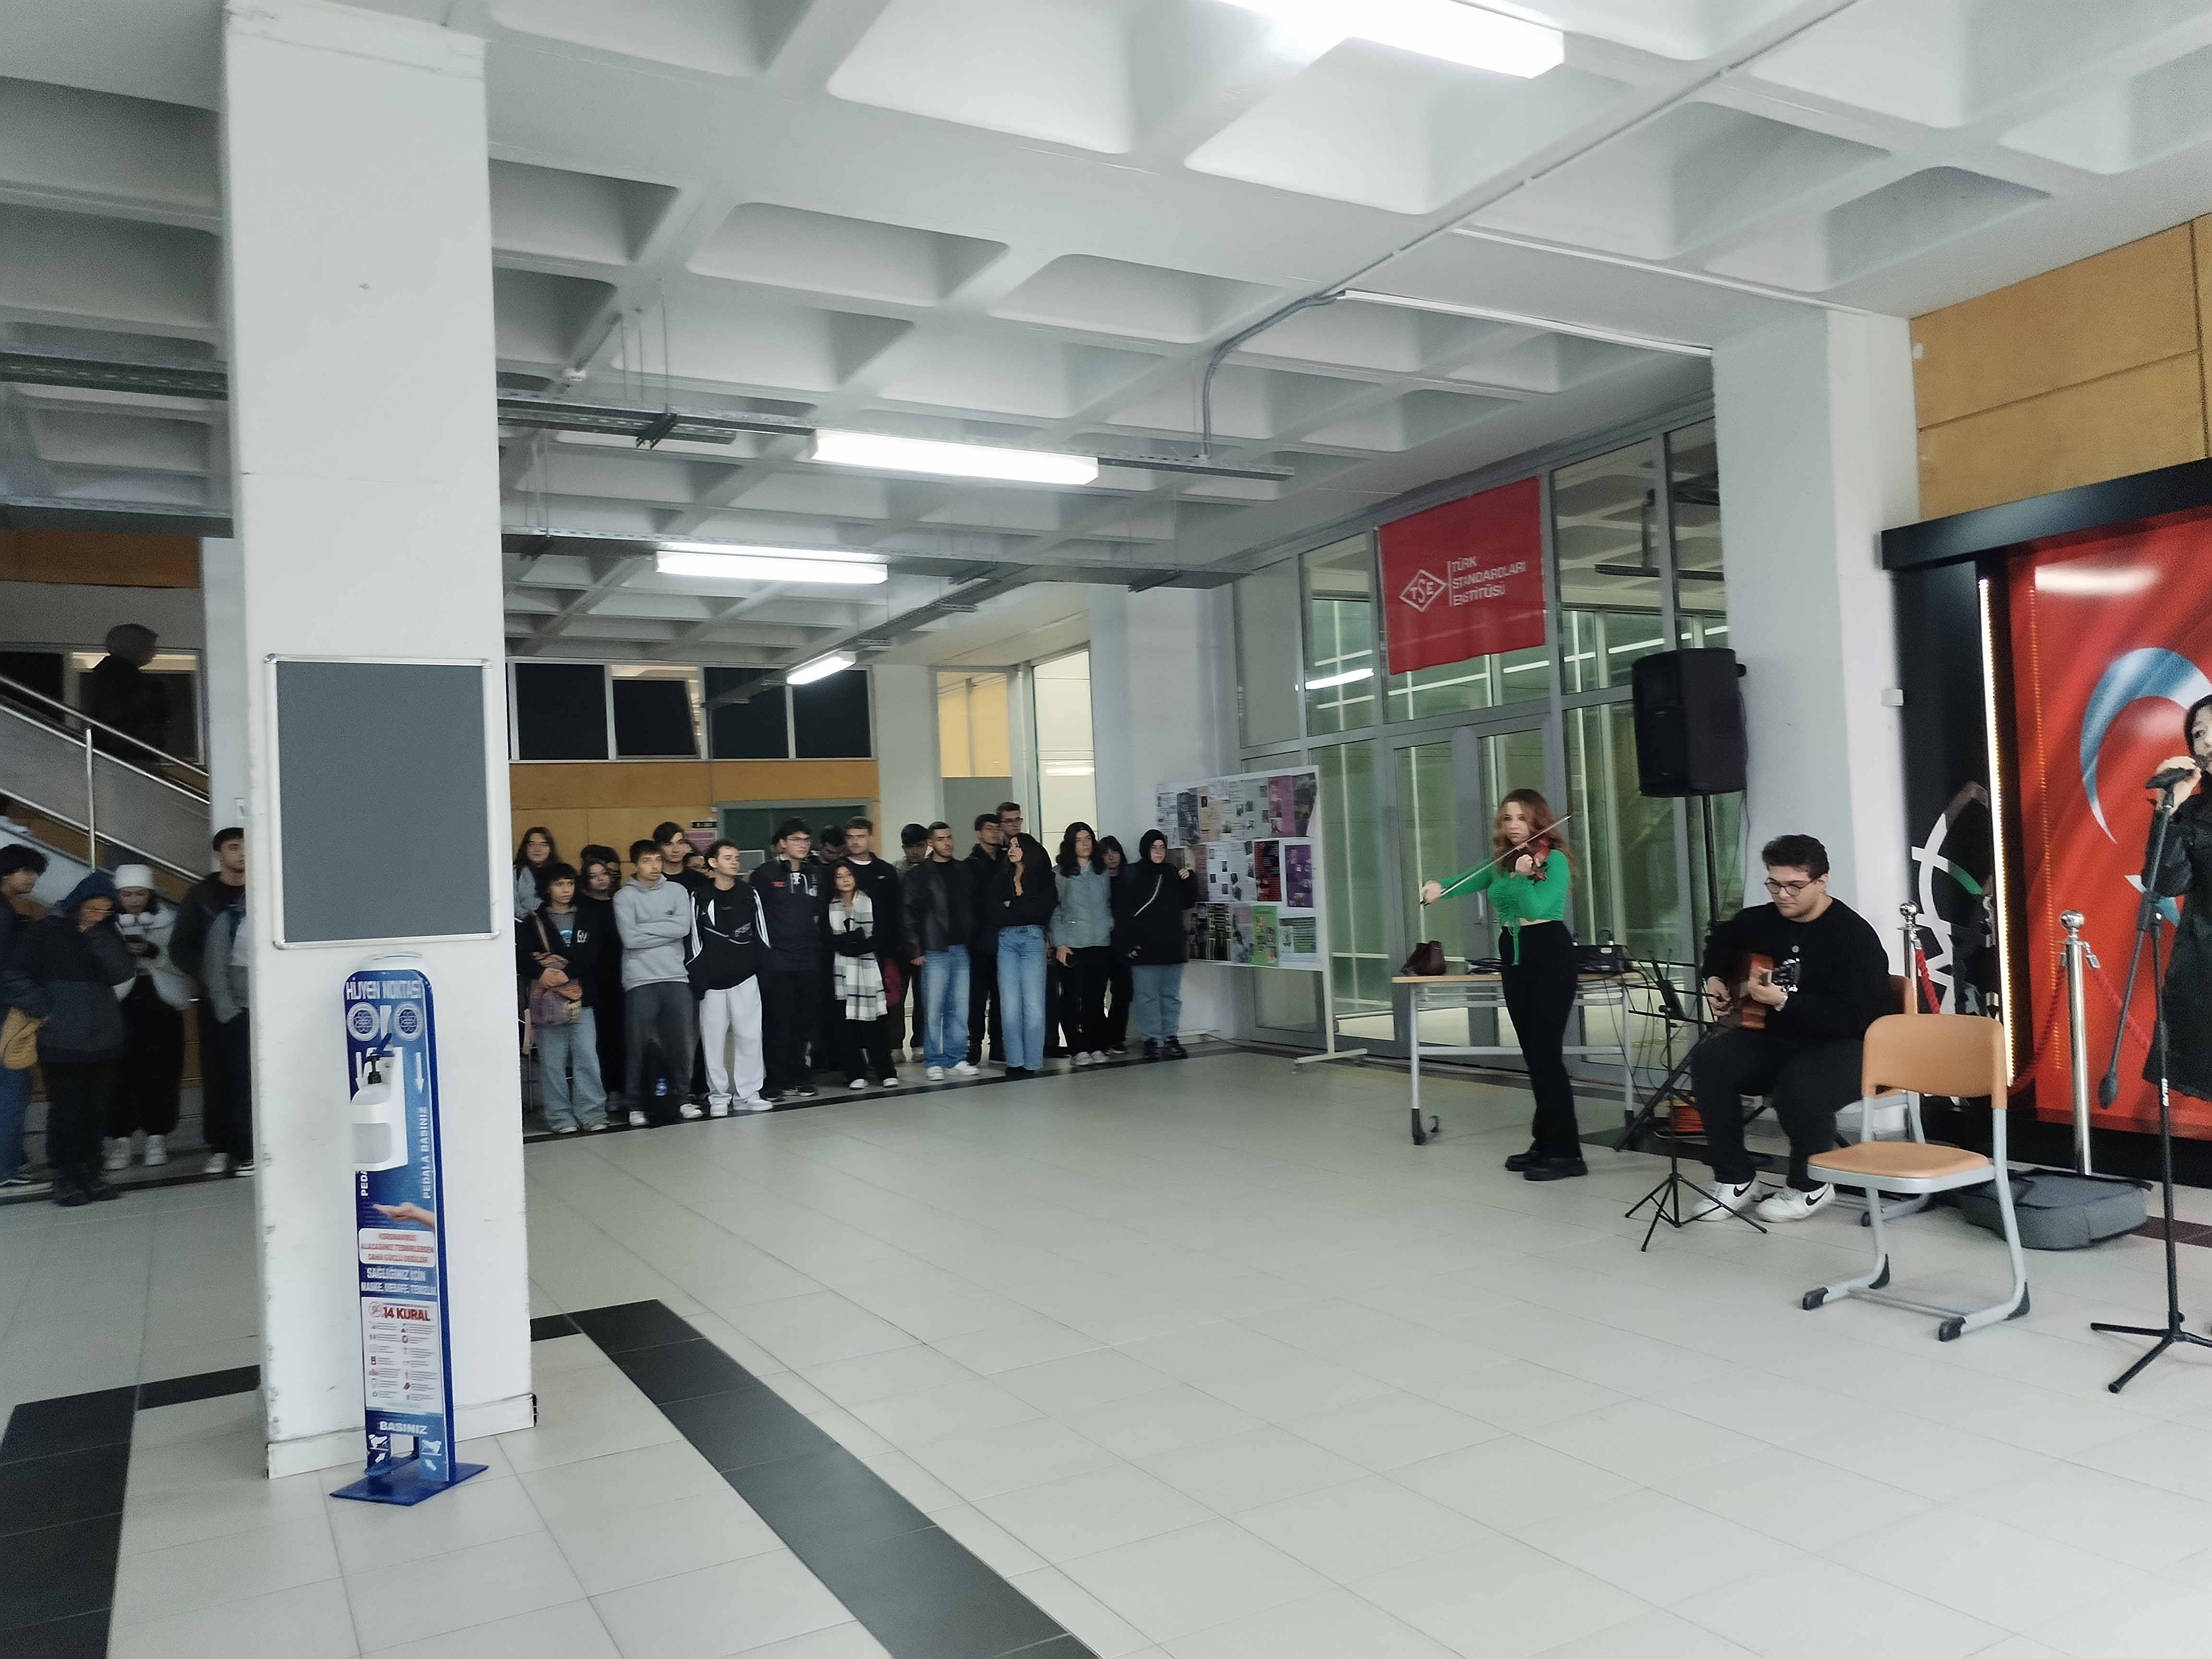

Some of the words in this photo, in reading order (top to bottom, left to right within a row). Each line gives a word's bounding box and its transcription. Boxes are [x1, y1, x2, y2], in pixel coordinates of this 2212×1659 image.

[1451, 556, 1478, 572] TÜRK
[1453, 561, 1527, 589] STANDARDLARI
[1410, 578, 1434, 603] TSE
[383, 1306, 394, 1319] 14
[397, 1307, 430, 1321] KURAL
[380, 1421, 427, 1434] BASINIZ
